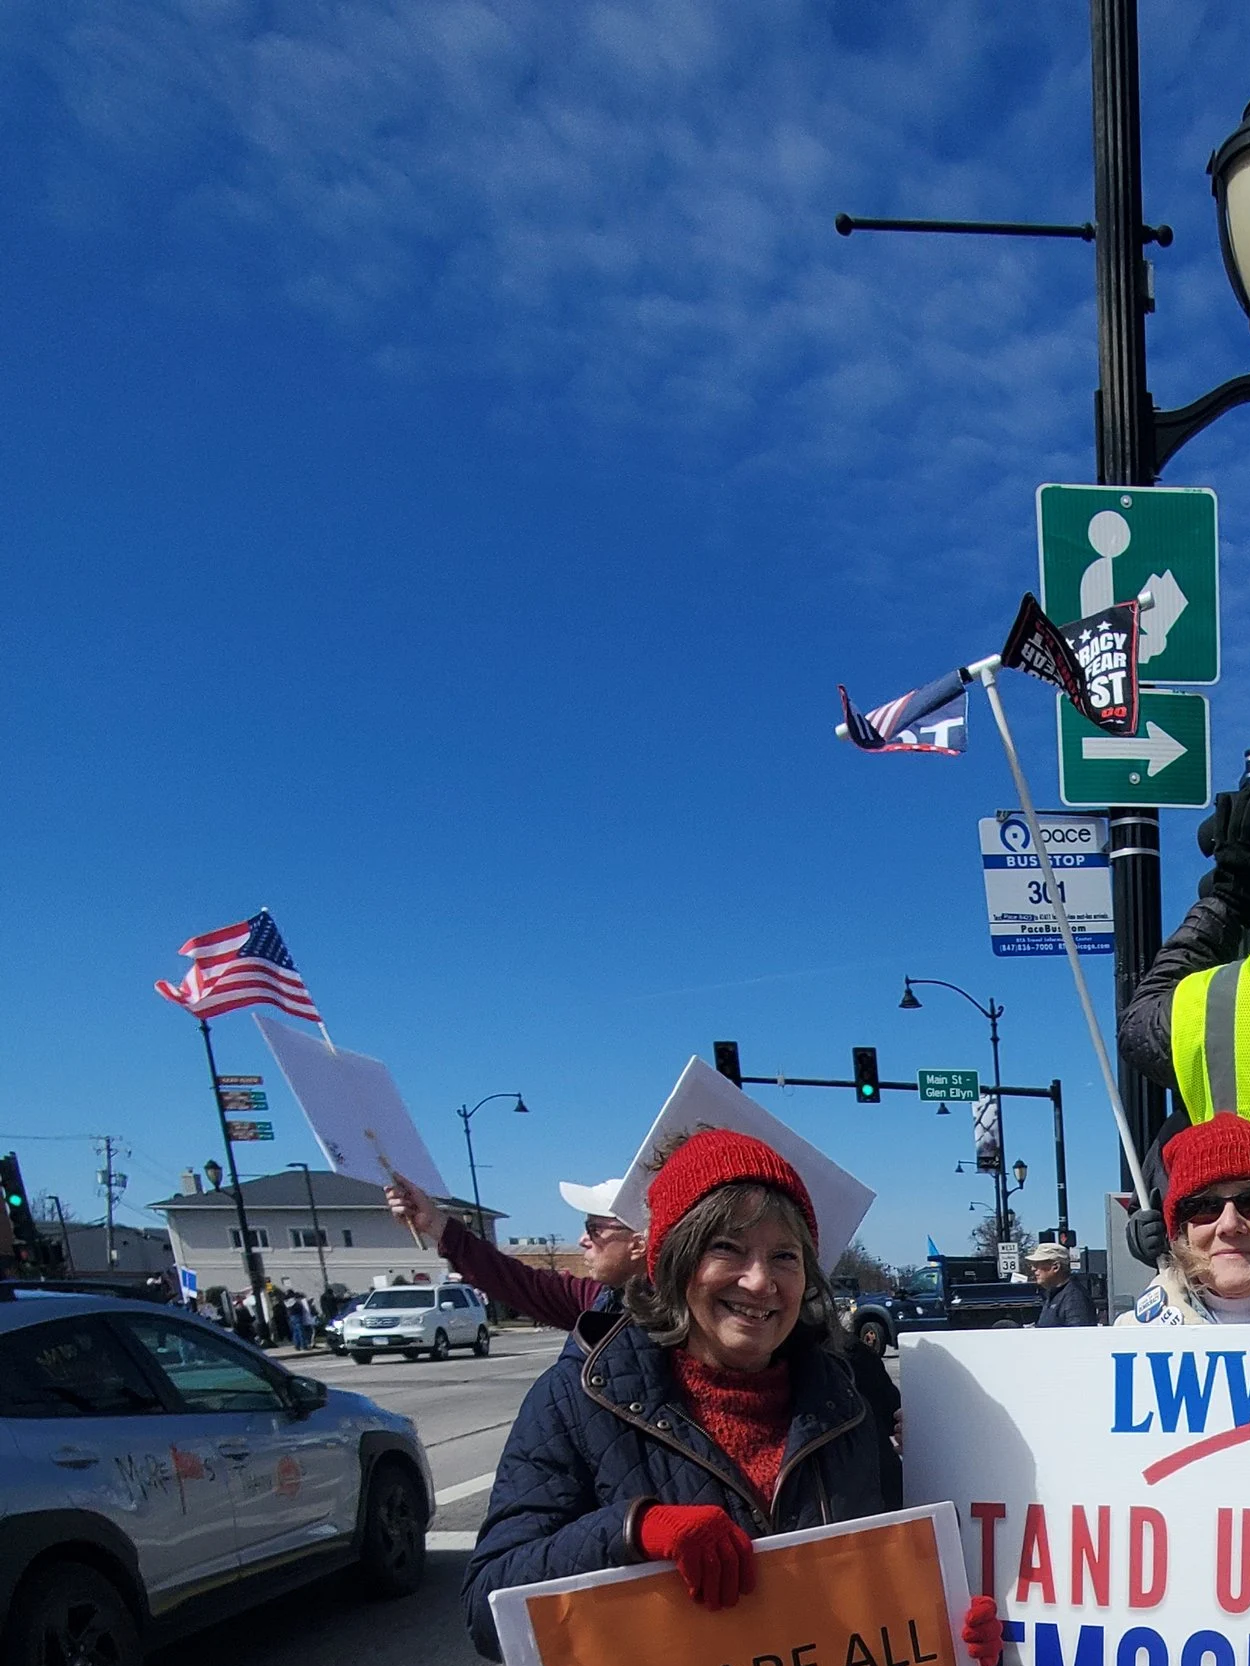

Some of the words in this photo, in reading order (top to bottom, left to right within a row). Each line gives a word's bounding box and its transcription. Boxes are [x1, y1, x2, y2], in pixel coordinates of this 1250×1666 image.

[1084, 652, 1127, 681] FEAR
[1005, 856, 1038, 867] BUS
[1021, 925, 1086, 933] PaceBusom
[926, 1075, 948, 1084] Main
[951, 1075, 962, 1085] St
[925, 1088, 946, 1097] Glen
[950, 1088, 973, 1099] Ellyn
[1002, 1261, 1016, 1270] 38
[1161, 1309, 1172, 1323] ICE
[1170, 1314, 1181, 1326] UT
[970, 1502, 1168, 1609] TAND
